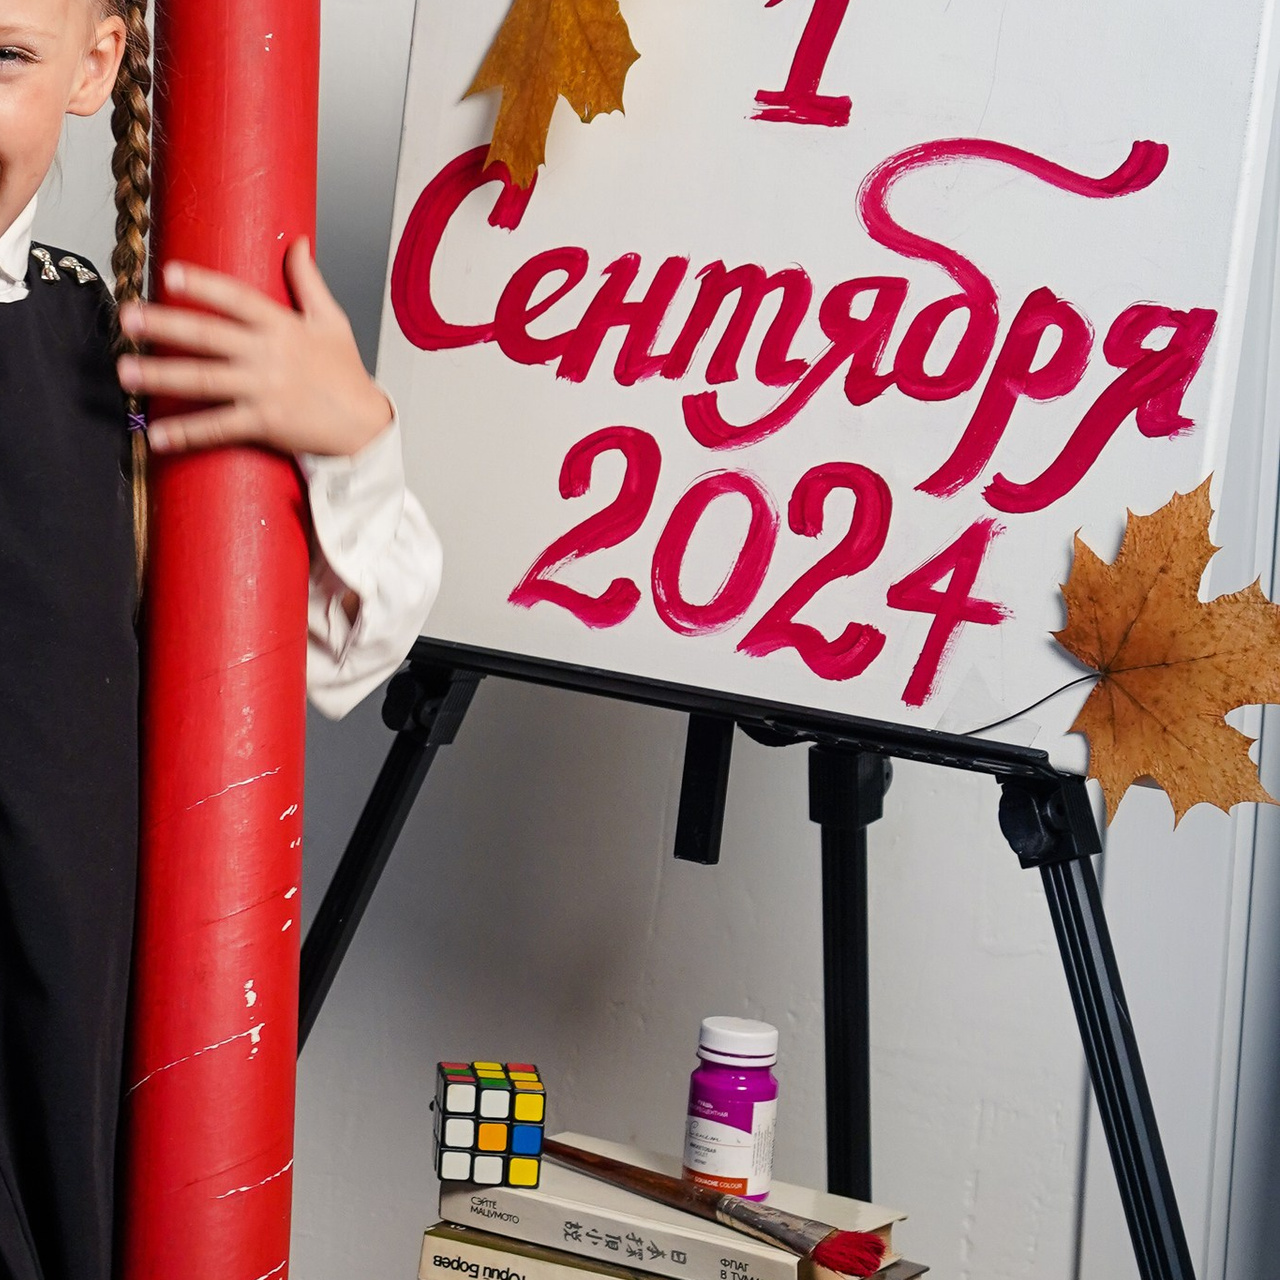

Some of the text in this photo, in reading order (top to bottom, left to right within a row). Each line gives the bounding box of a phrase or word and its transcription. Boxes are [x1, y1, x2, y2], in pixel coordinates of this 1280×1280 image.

[390, 137, 1219, 513] Сентября
[509, 425, 1014, 708] 2024
[470, 1205, 520, 1224] МАЦУМОТО
[433, 1255, 480, 1279] Борев
[720, 1258, 749, 1273] ФЛАГ
[720, 1269, 728, 1280] В
